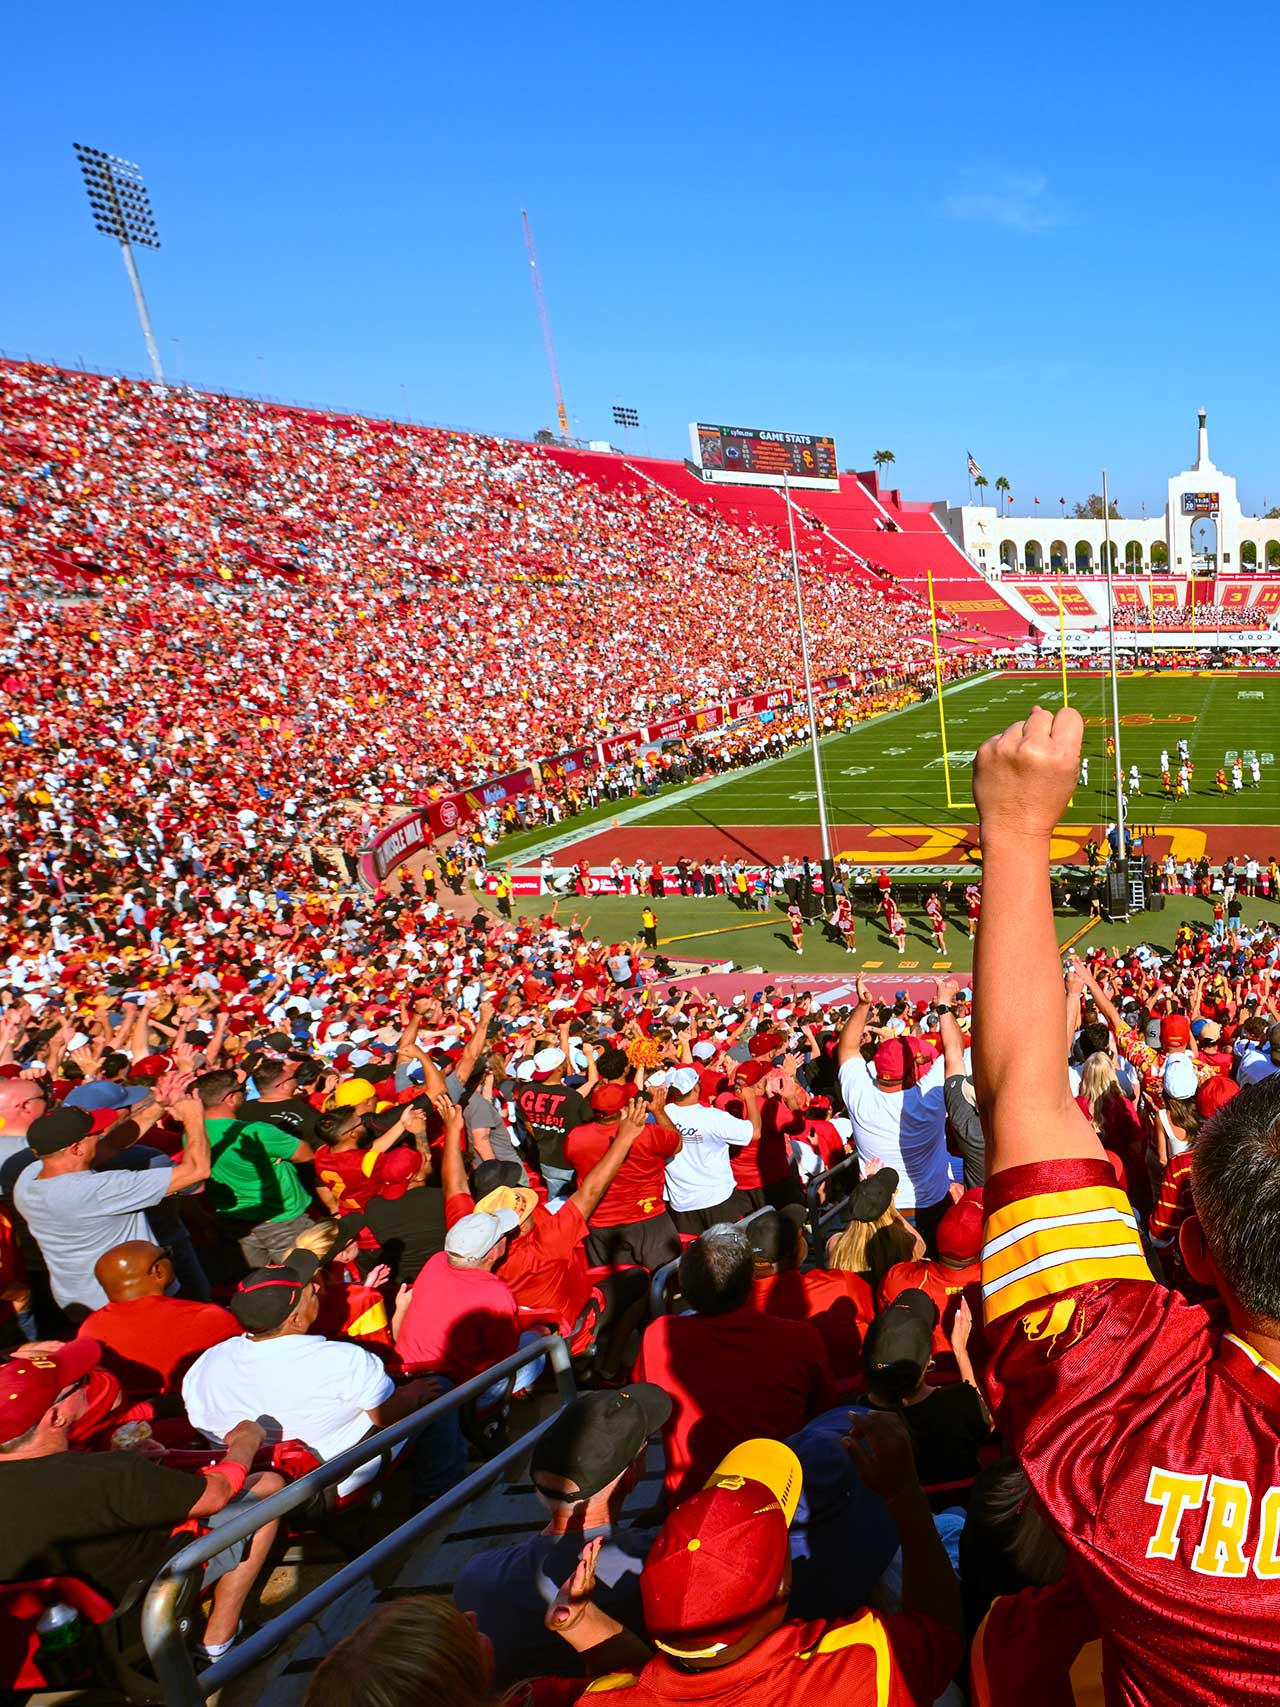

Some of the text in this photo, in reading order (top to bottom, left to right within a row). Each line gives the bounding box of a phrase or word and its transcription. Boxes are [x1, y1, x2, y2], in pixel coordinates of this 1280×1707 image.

[759, 431, 784, 442] GAME
[785, 434, 811, 445] STATS
[1025, 594, 1049, 603] 20
[1062, 594, 1085, 603] 32
[1119, 593, 1139, 602] 12
[1153, 593, 1174, 602] 33
[1230, 593, 1242, 601] 3
[1262, 593, 1278, 601] 11
[660, 723, 679, 734] UNITED
[520, 1090, 567, 1115] GET
[945, 1286, 964, 1295] USC
[180, 1619, 188, 1632] 9
